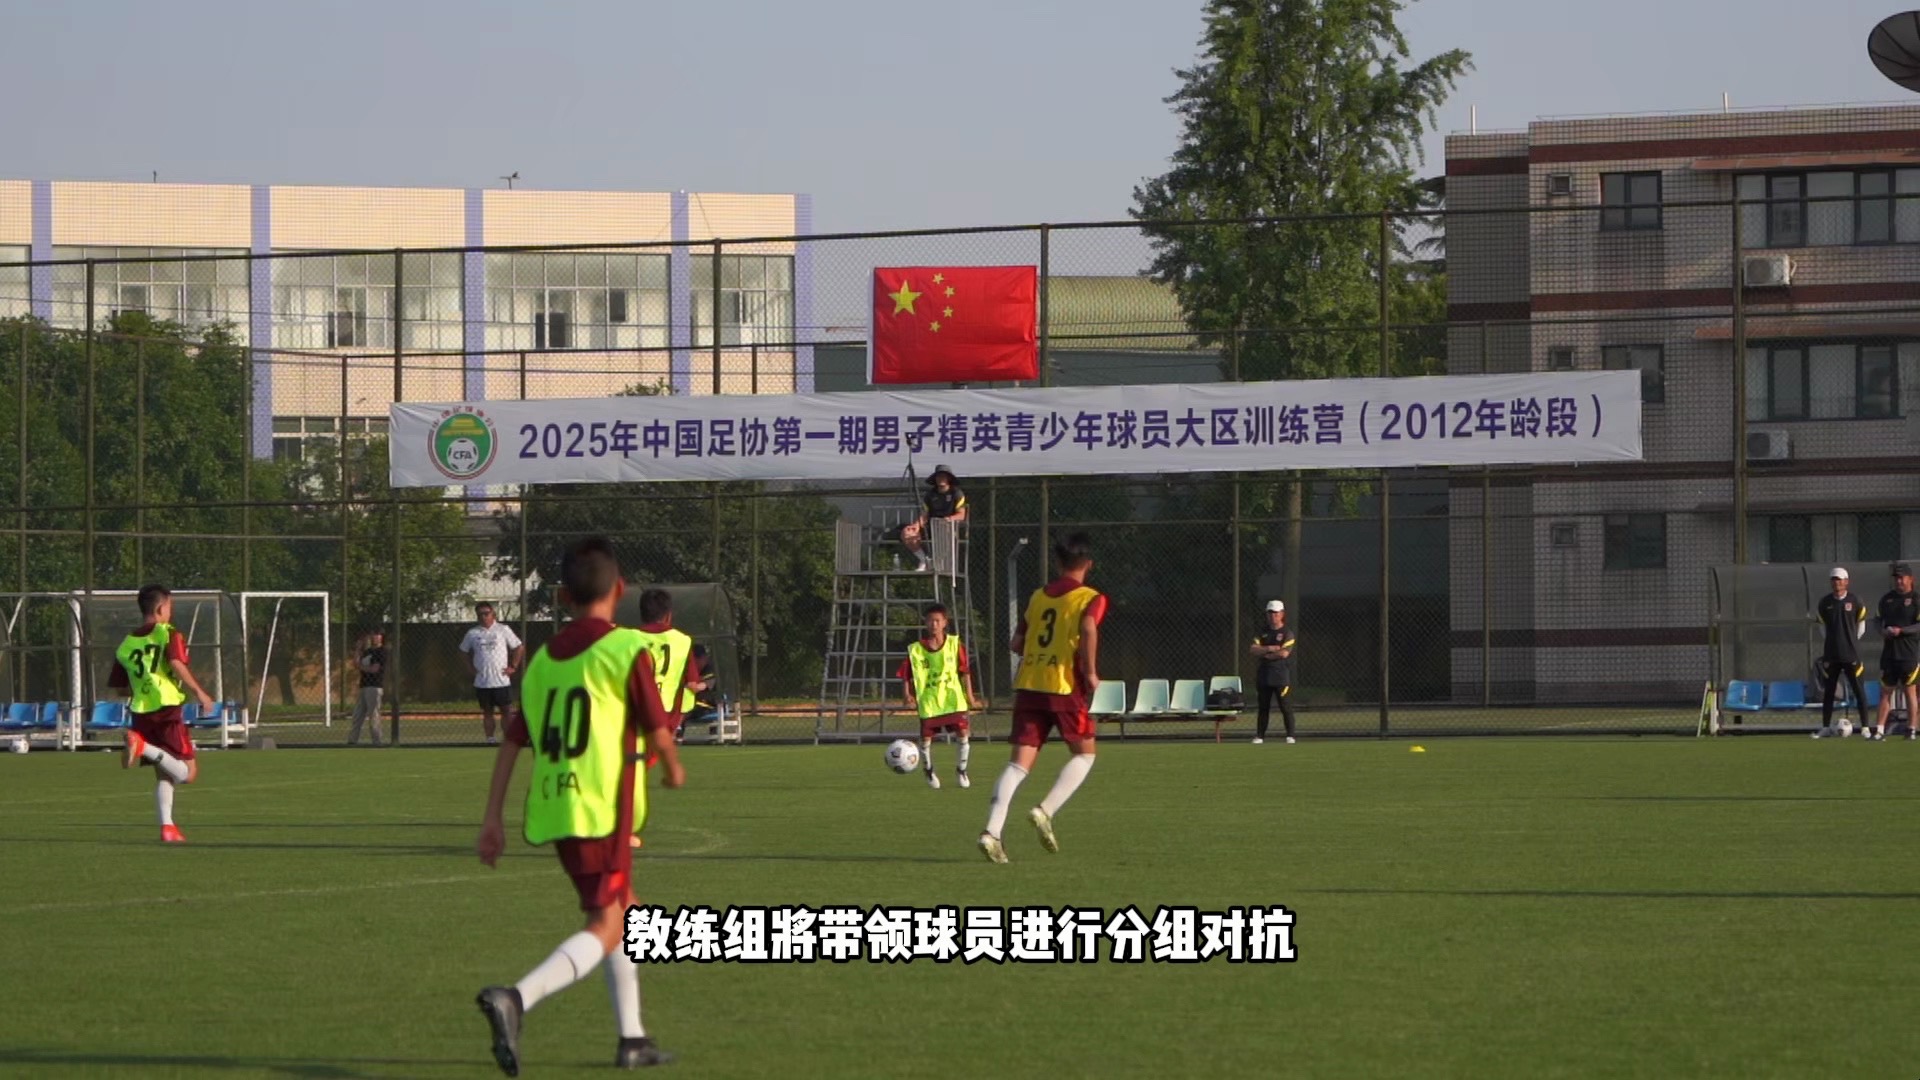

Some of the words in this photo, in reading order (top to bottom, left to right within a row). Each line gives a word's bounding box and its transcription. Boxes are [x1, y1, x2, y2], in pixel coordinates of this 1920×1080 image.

[452, 450, 473, 460] CFA
[1037, 607, 1057, 648] 3
[129, 644, 161, 679] 37
[1024, 654, 1058, 667] CFA
[541, 686, 592, 763] 40
[542, 772, 581, 800] CFA
